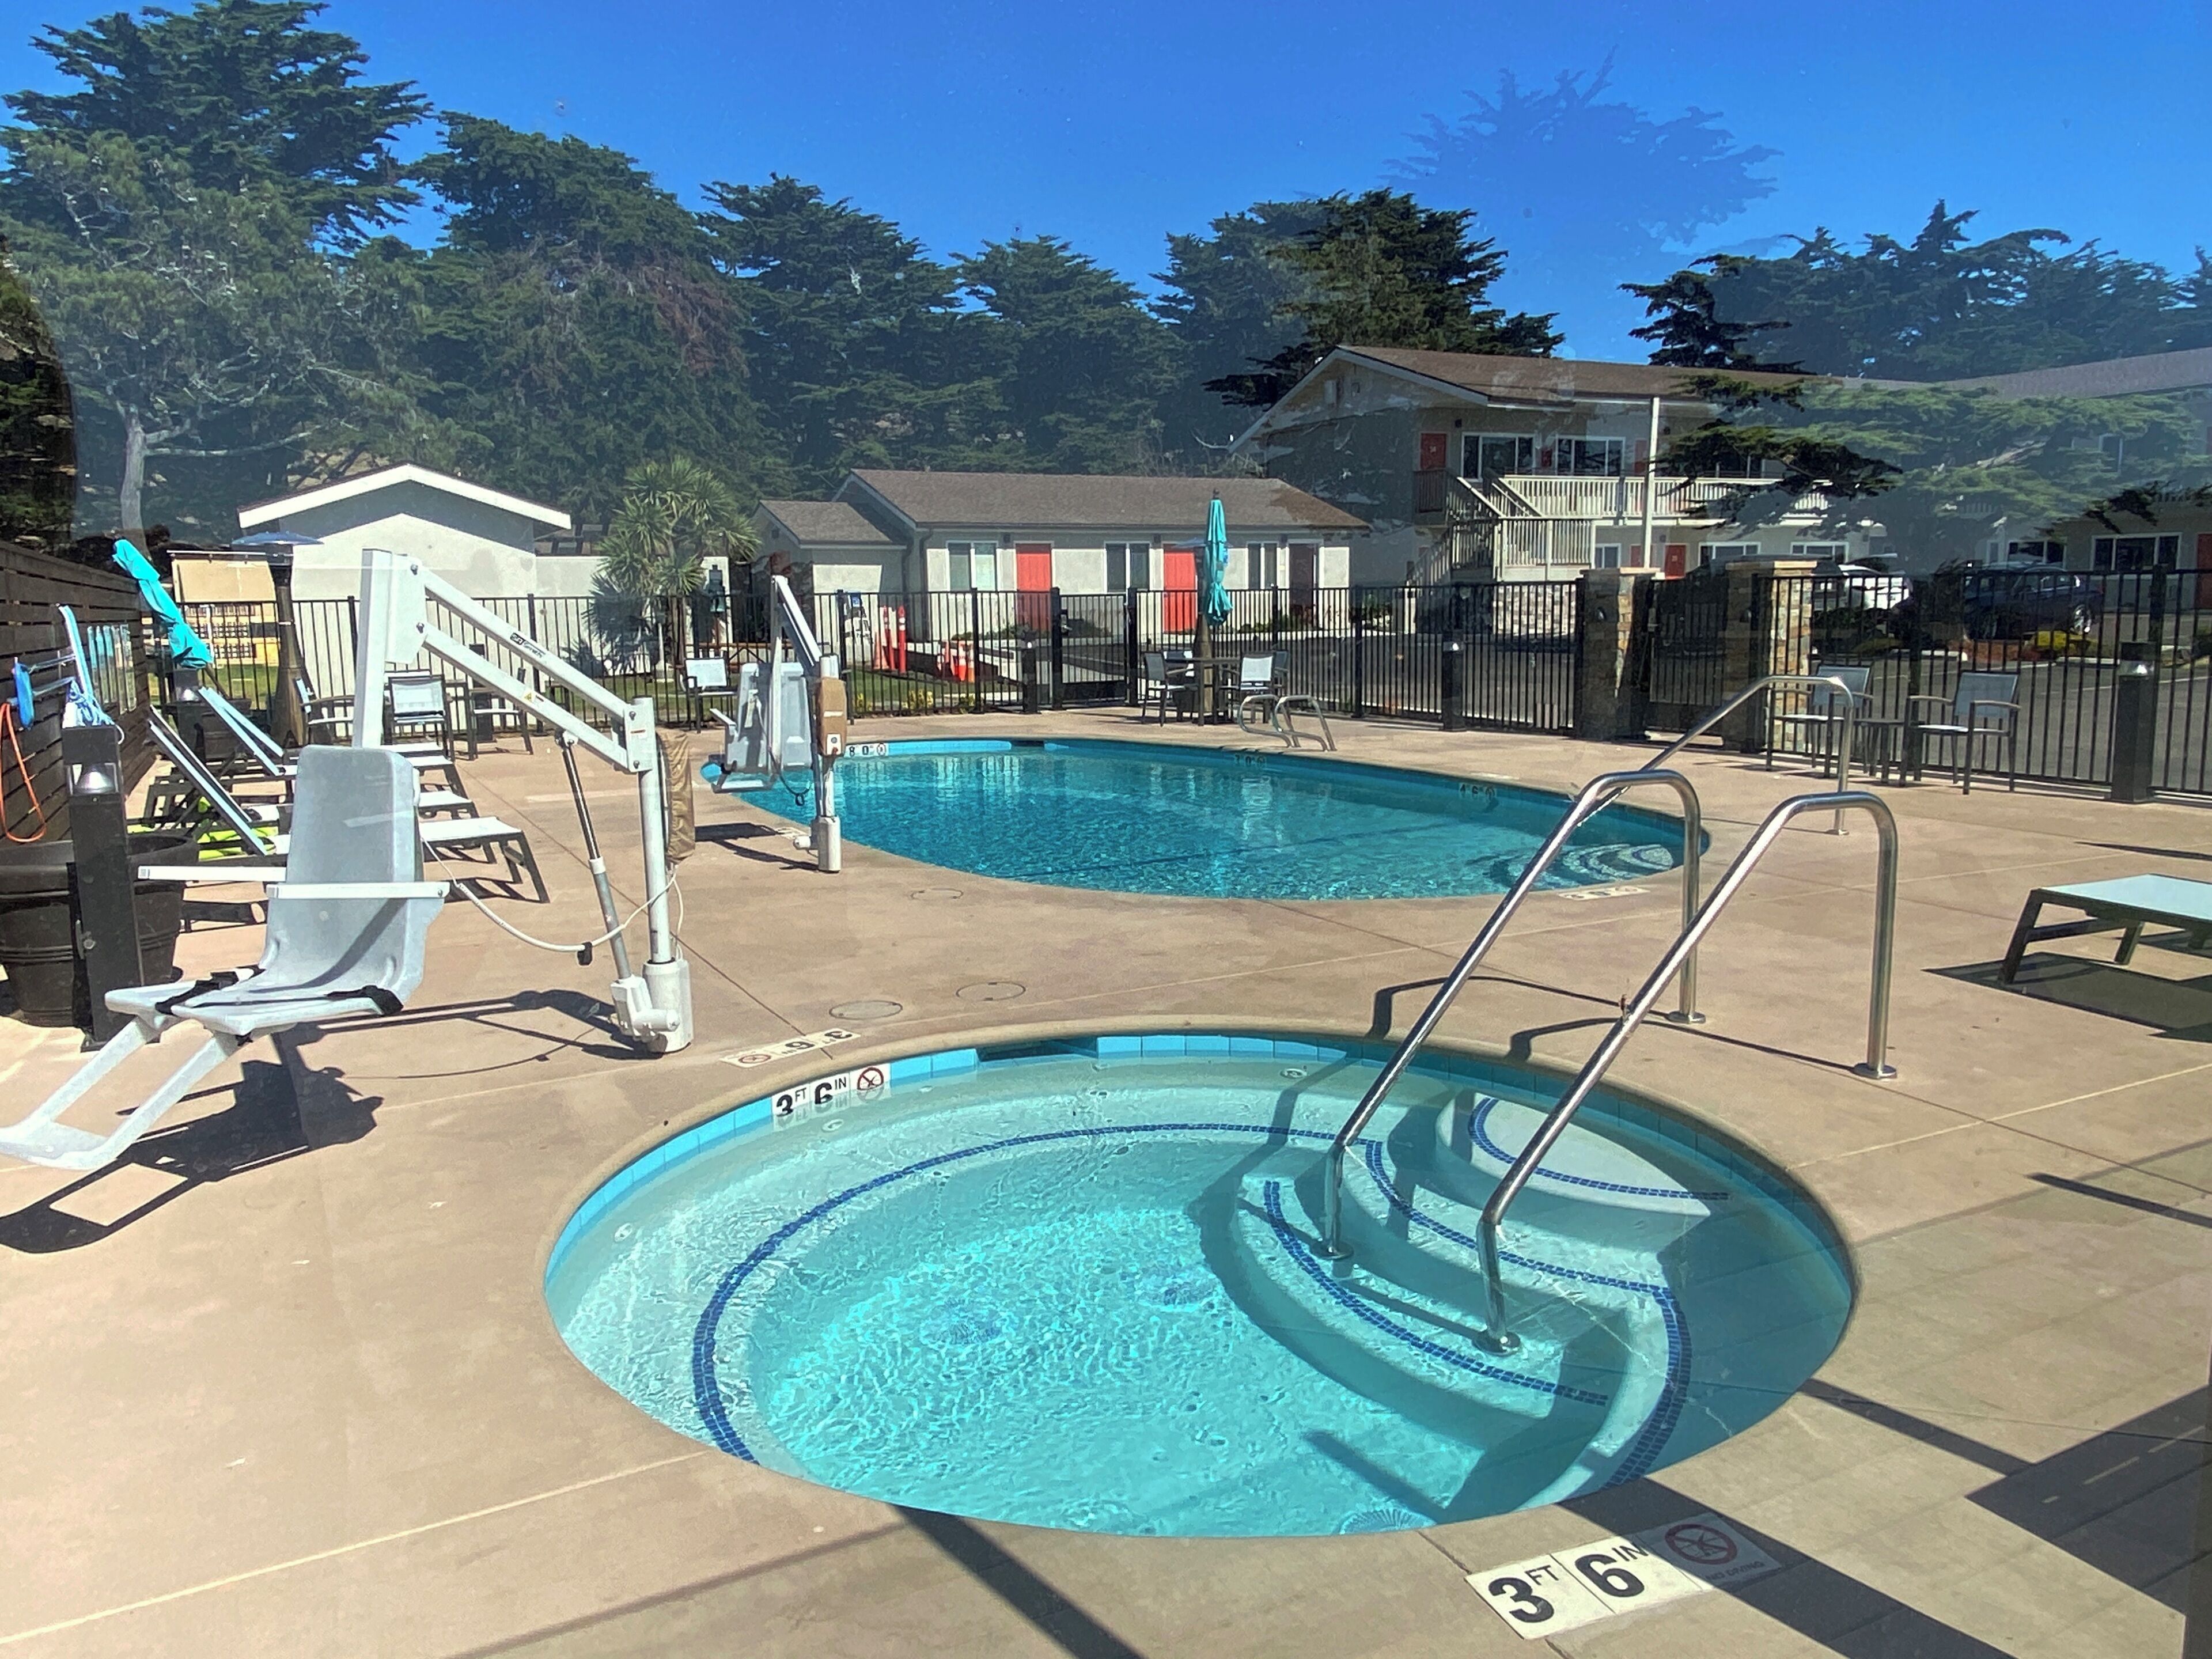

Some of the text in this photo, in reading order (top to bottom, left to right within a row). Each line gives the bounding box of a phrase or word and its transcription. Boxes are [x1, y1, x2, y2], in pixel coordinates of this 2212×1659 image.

[849, 745, 869, 757] 8 0
[776, 1076, 847, 1117] 3 FT 6 IN
[1488, 1543, 1649, 1623] 3 FT 6 IN
[1705, 1571, 1726, 1580] NO
